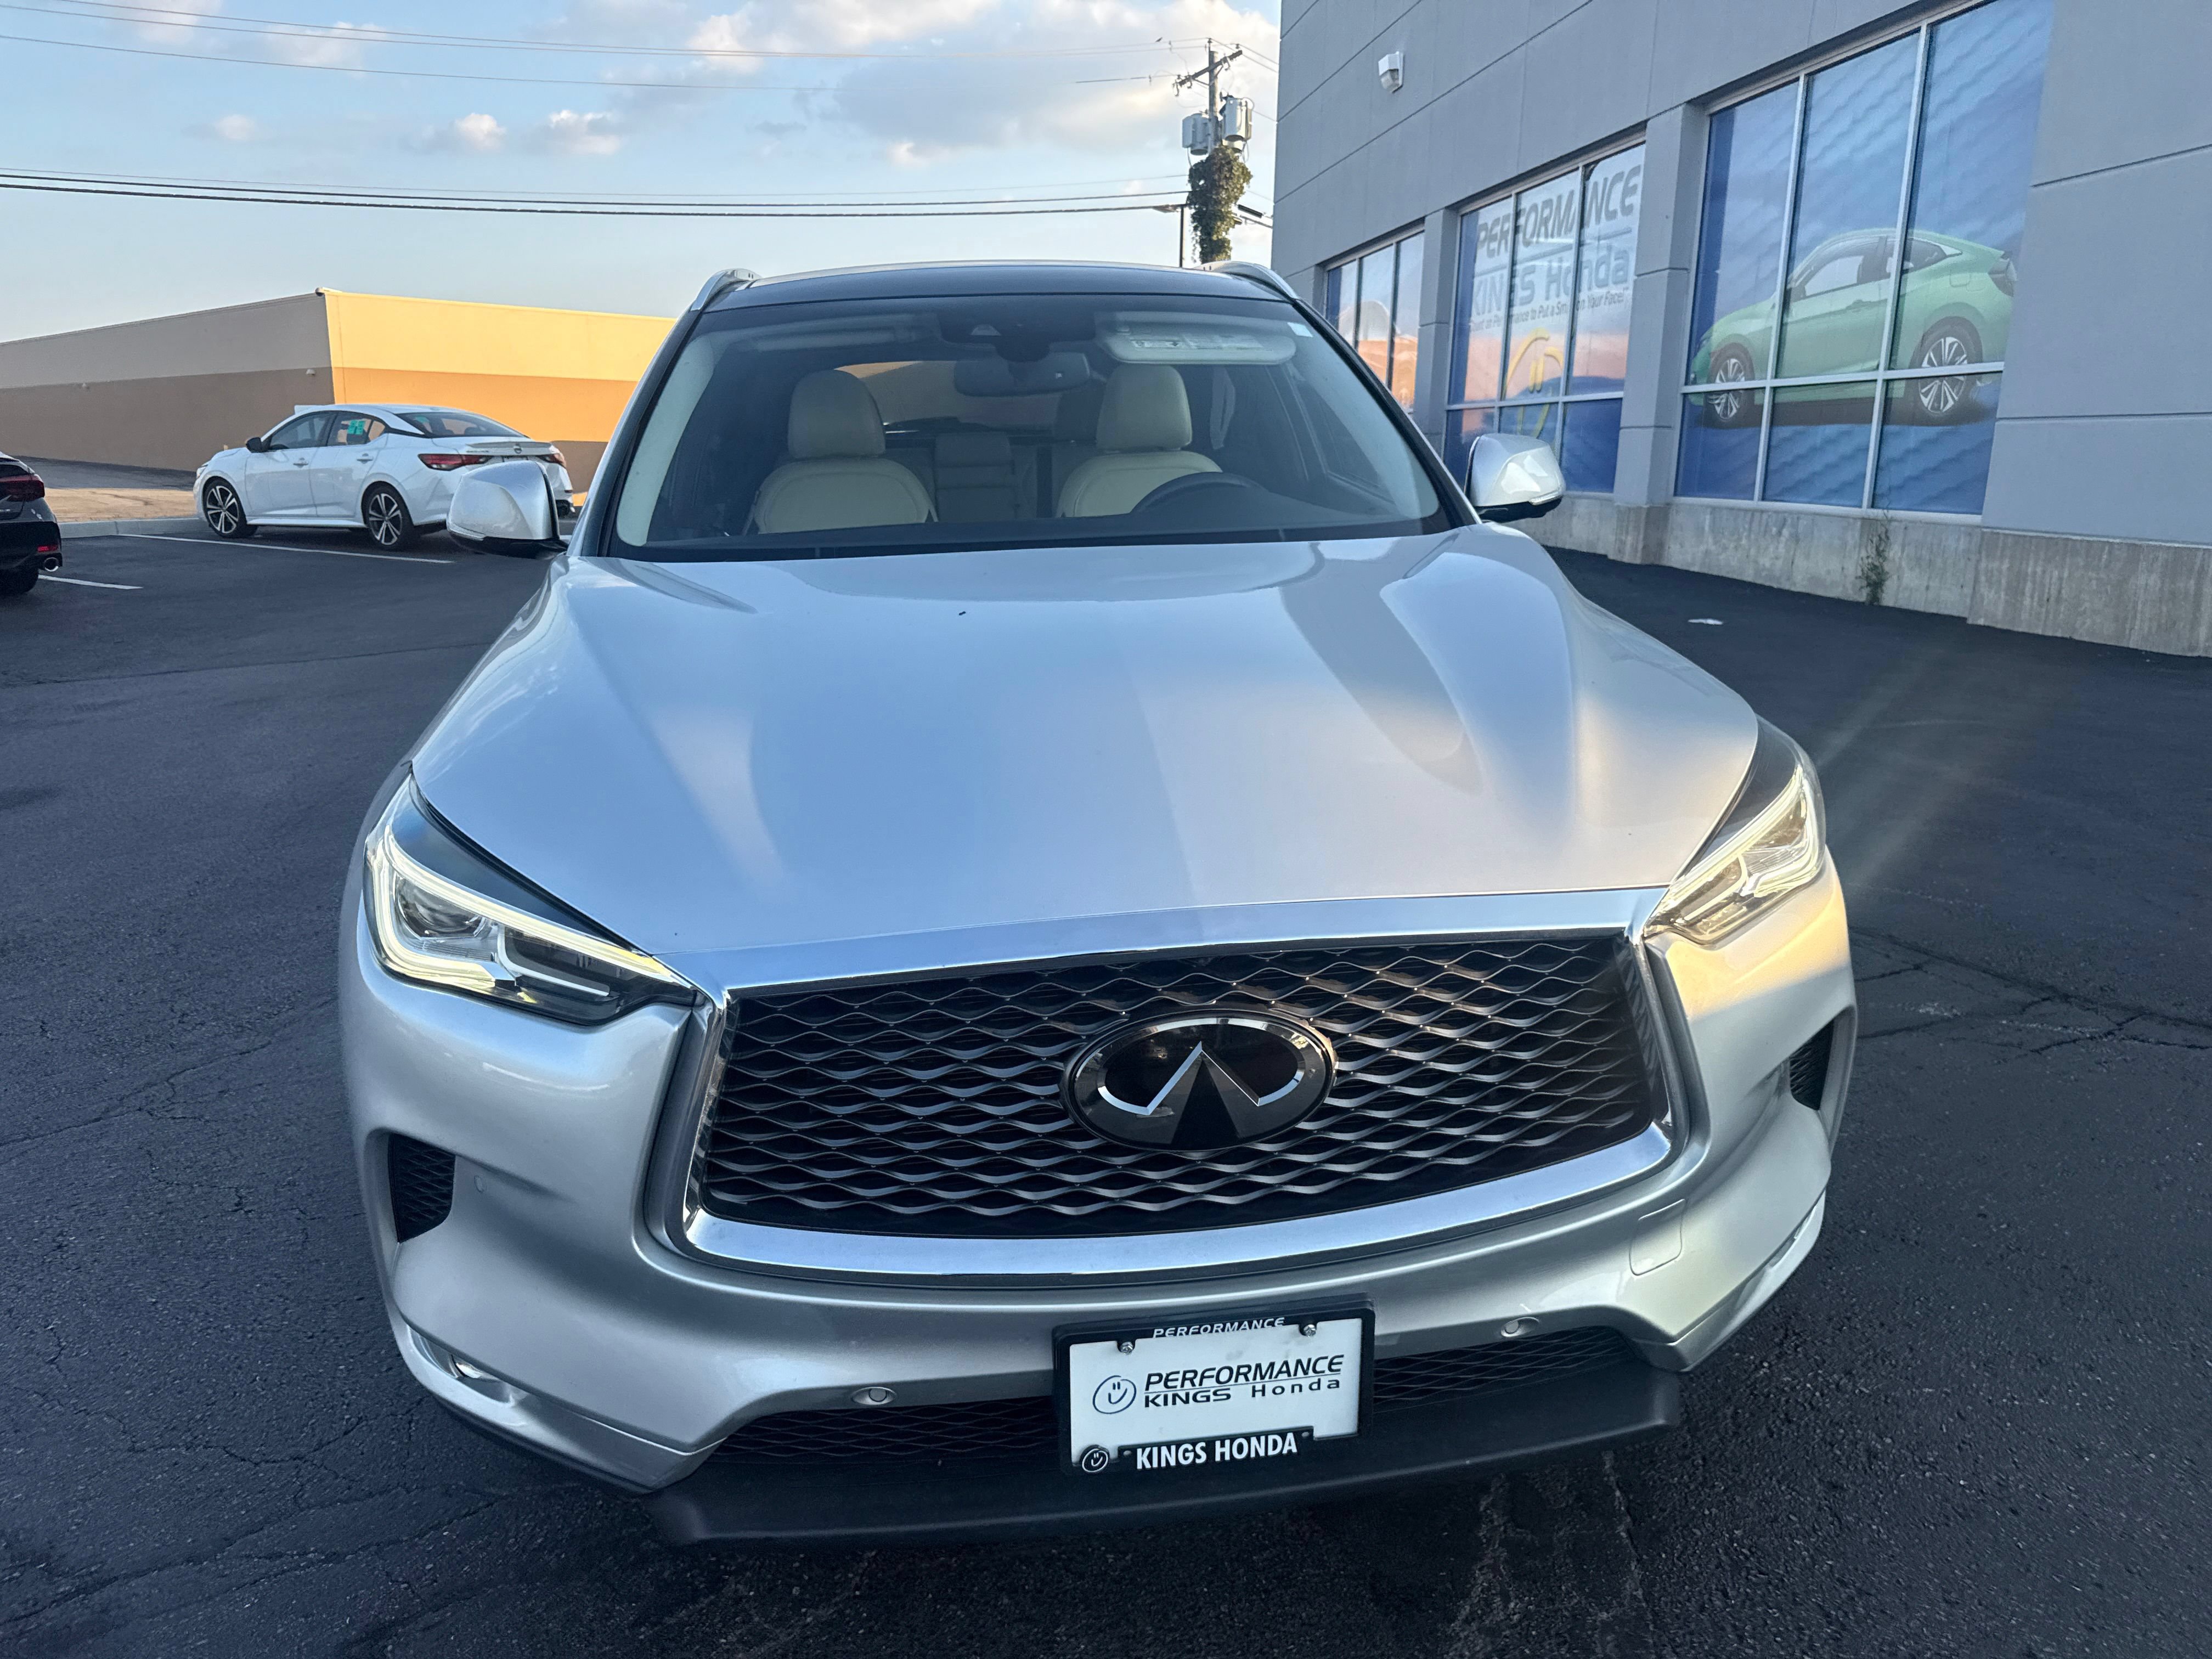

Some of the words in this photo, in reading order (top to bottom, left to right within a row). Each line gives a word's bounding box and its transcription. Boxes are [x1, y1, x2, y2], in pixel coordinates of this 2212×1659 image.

[1472, 263, 1536, 315] KINS
[1153, 1317, 1285, 1339] PERFORMANCE
[1145, 1355, 1344, 1391] PERFORMANCE
[1144, 1387, 1231, 1408] KINGS
[1251, 1378, 1340, 1398] Honda
[1137, 1441, 1207, 1470] KINGS
[1215, 1432, 1298, 1462] HONDA
